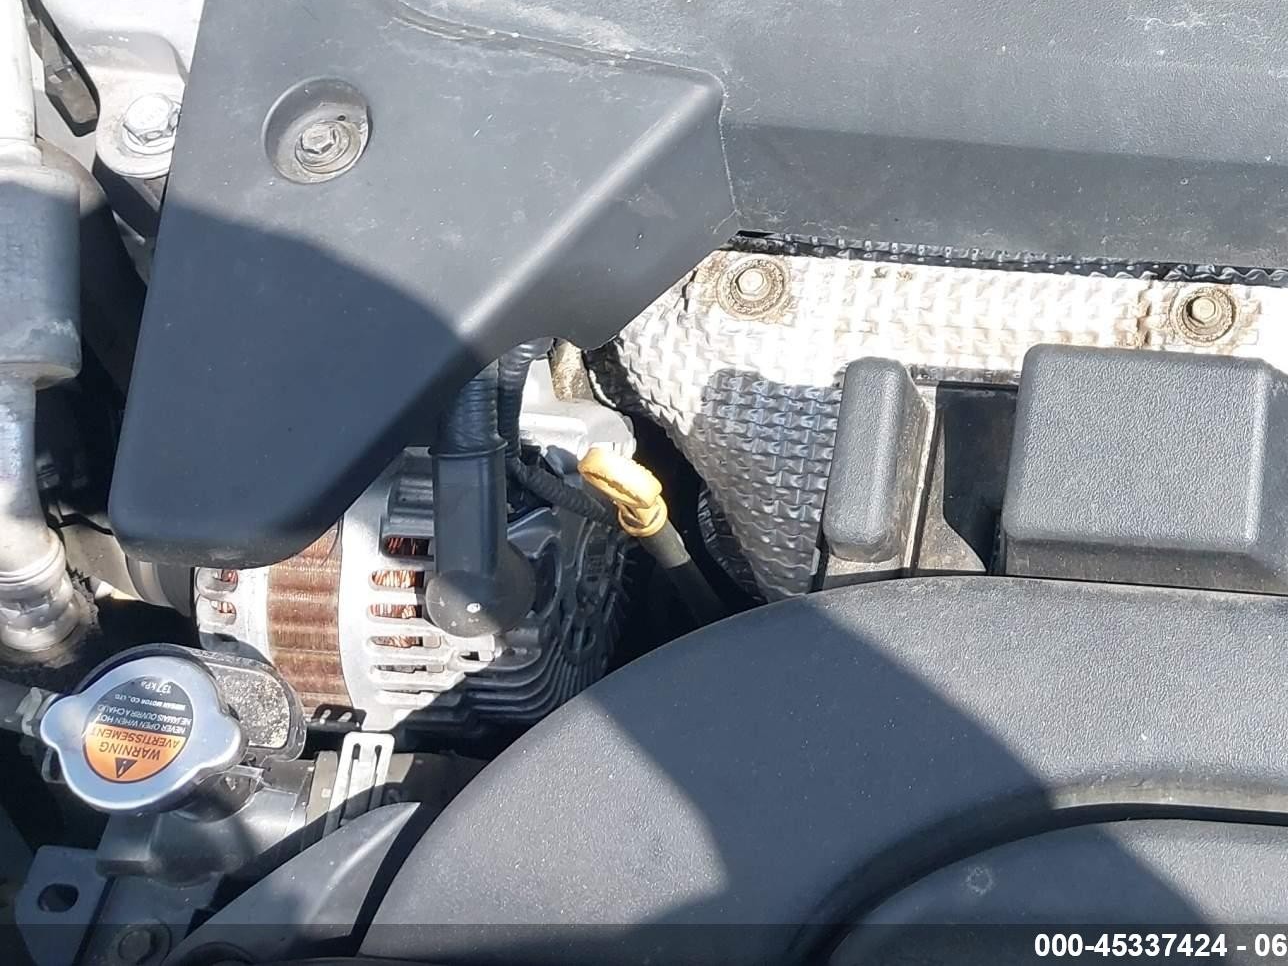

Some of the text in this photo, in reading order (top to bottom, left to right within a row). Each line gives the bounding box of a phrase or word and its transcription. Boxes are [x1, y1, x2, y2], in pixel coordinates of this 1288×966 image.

[141, 698, 162, 707] MOTOR
[130, 710, 157, 720] OUVRIR
[157, 714, 182, 724] JAMAIS
[114, 717, 139, 727] WHEN
[139, 721, 161, 730] OPEN
[182, 717, 192, 726] NE
[161, 724, 186, 734] NEVER
[91, 727, 180, 749] AVERTISSEMENT
[98, 741, 161, 761] WARNING
